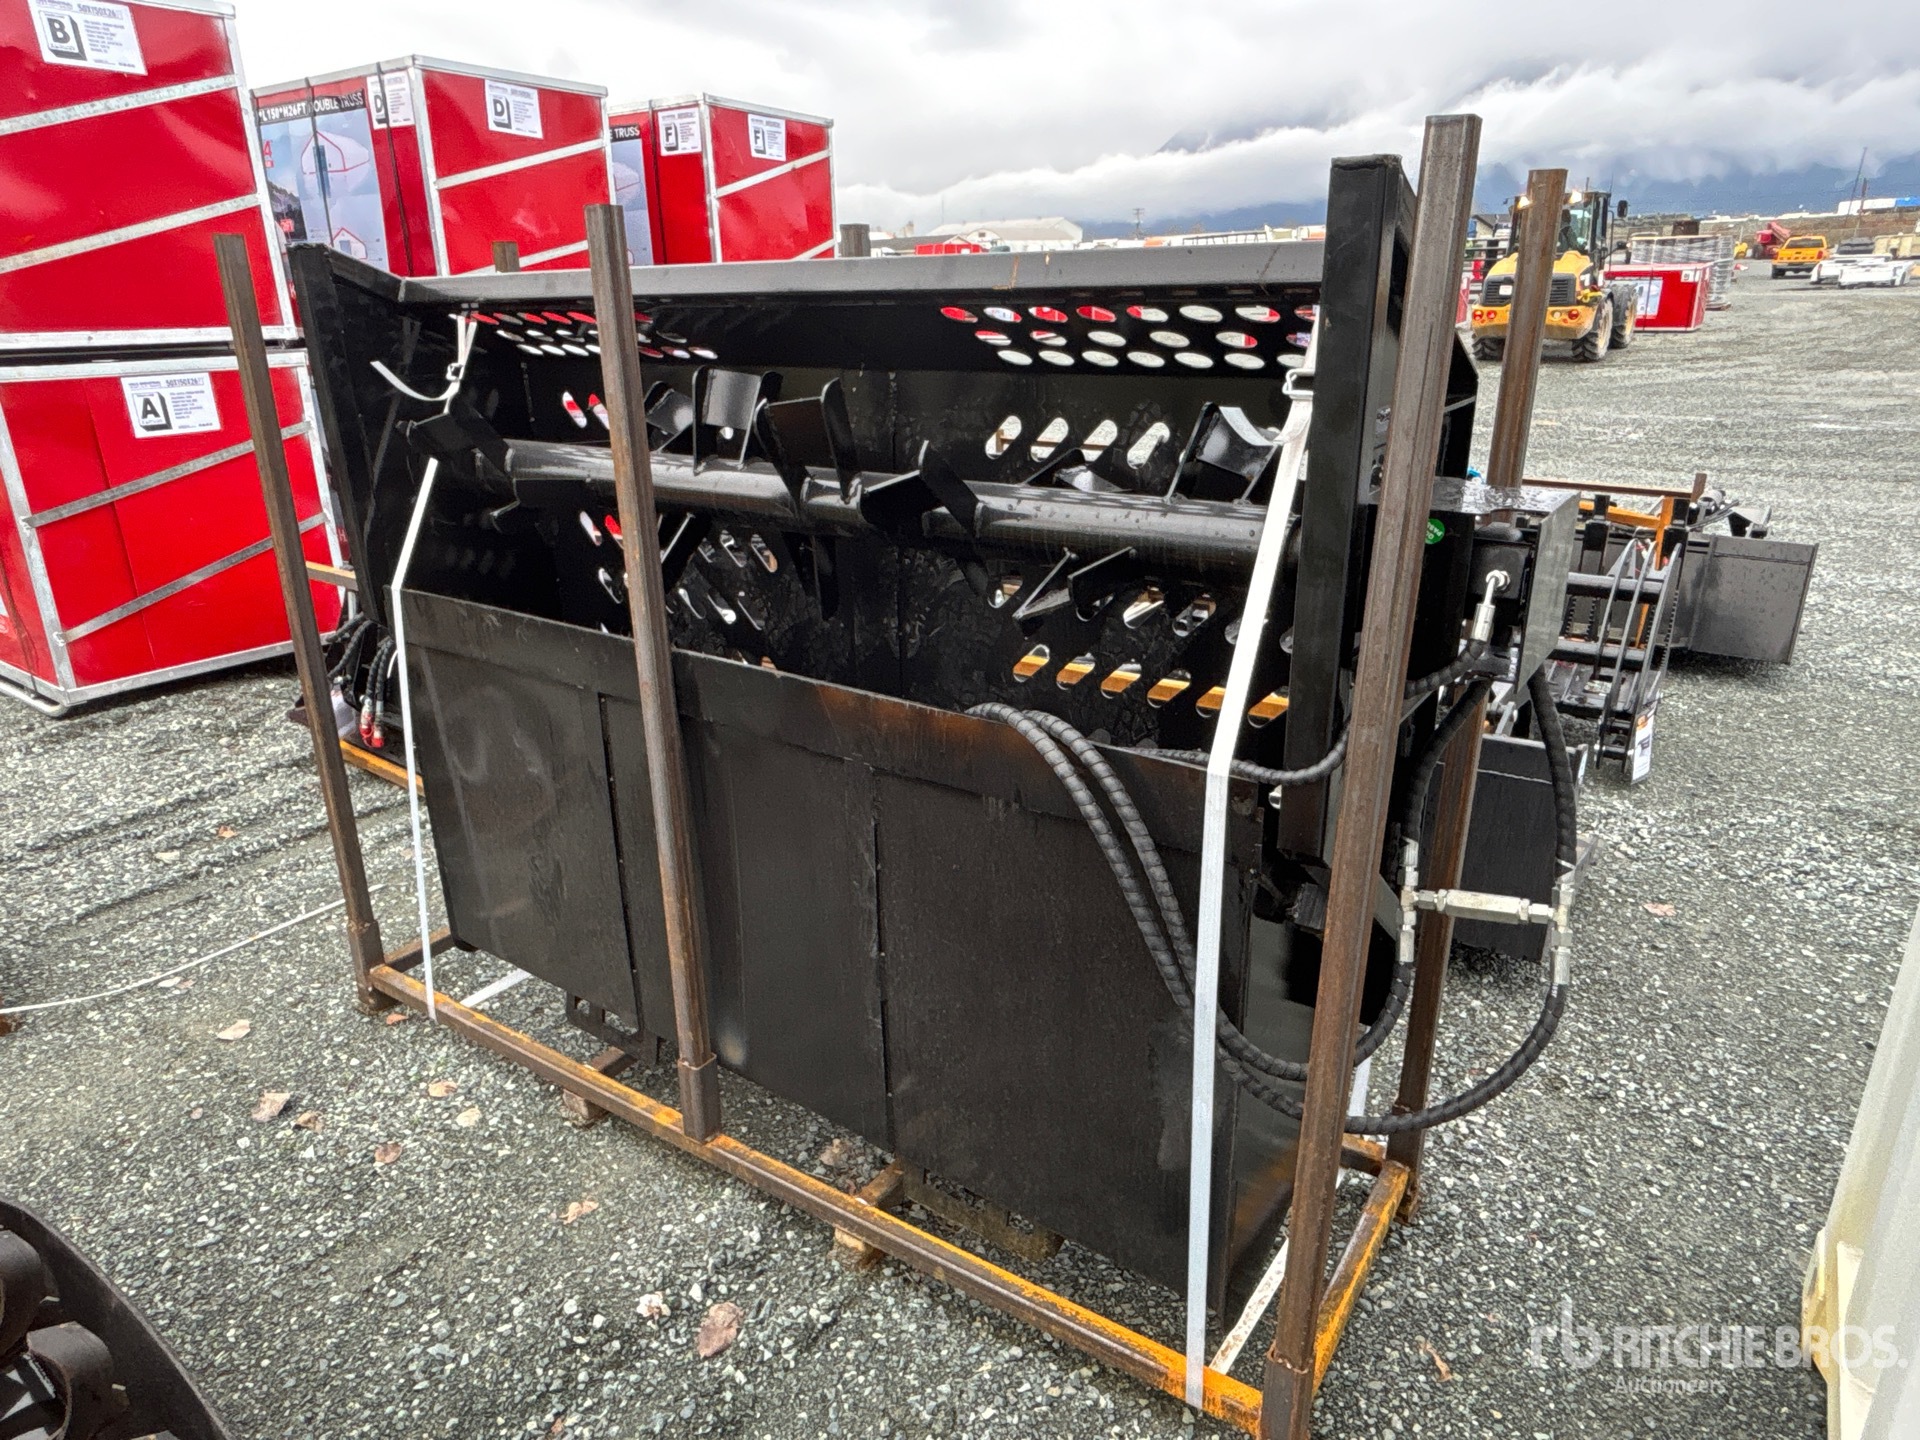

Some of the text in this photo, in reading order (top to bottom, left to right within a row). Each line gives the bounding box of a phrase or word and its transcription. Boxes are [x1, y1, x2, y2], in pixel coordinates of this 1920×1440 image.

[46, 17, 70, 45] B
[340, 91, 365, 108] TRUSS
[373, 94, 384, 113] D
[493, 98, 505, 117] D
[614, 125, 640, 139] TRUSS
[664, 126, 673, 143] F
[753, 129, 762, 145] F
[141, 397, 161, 420] A
